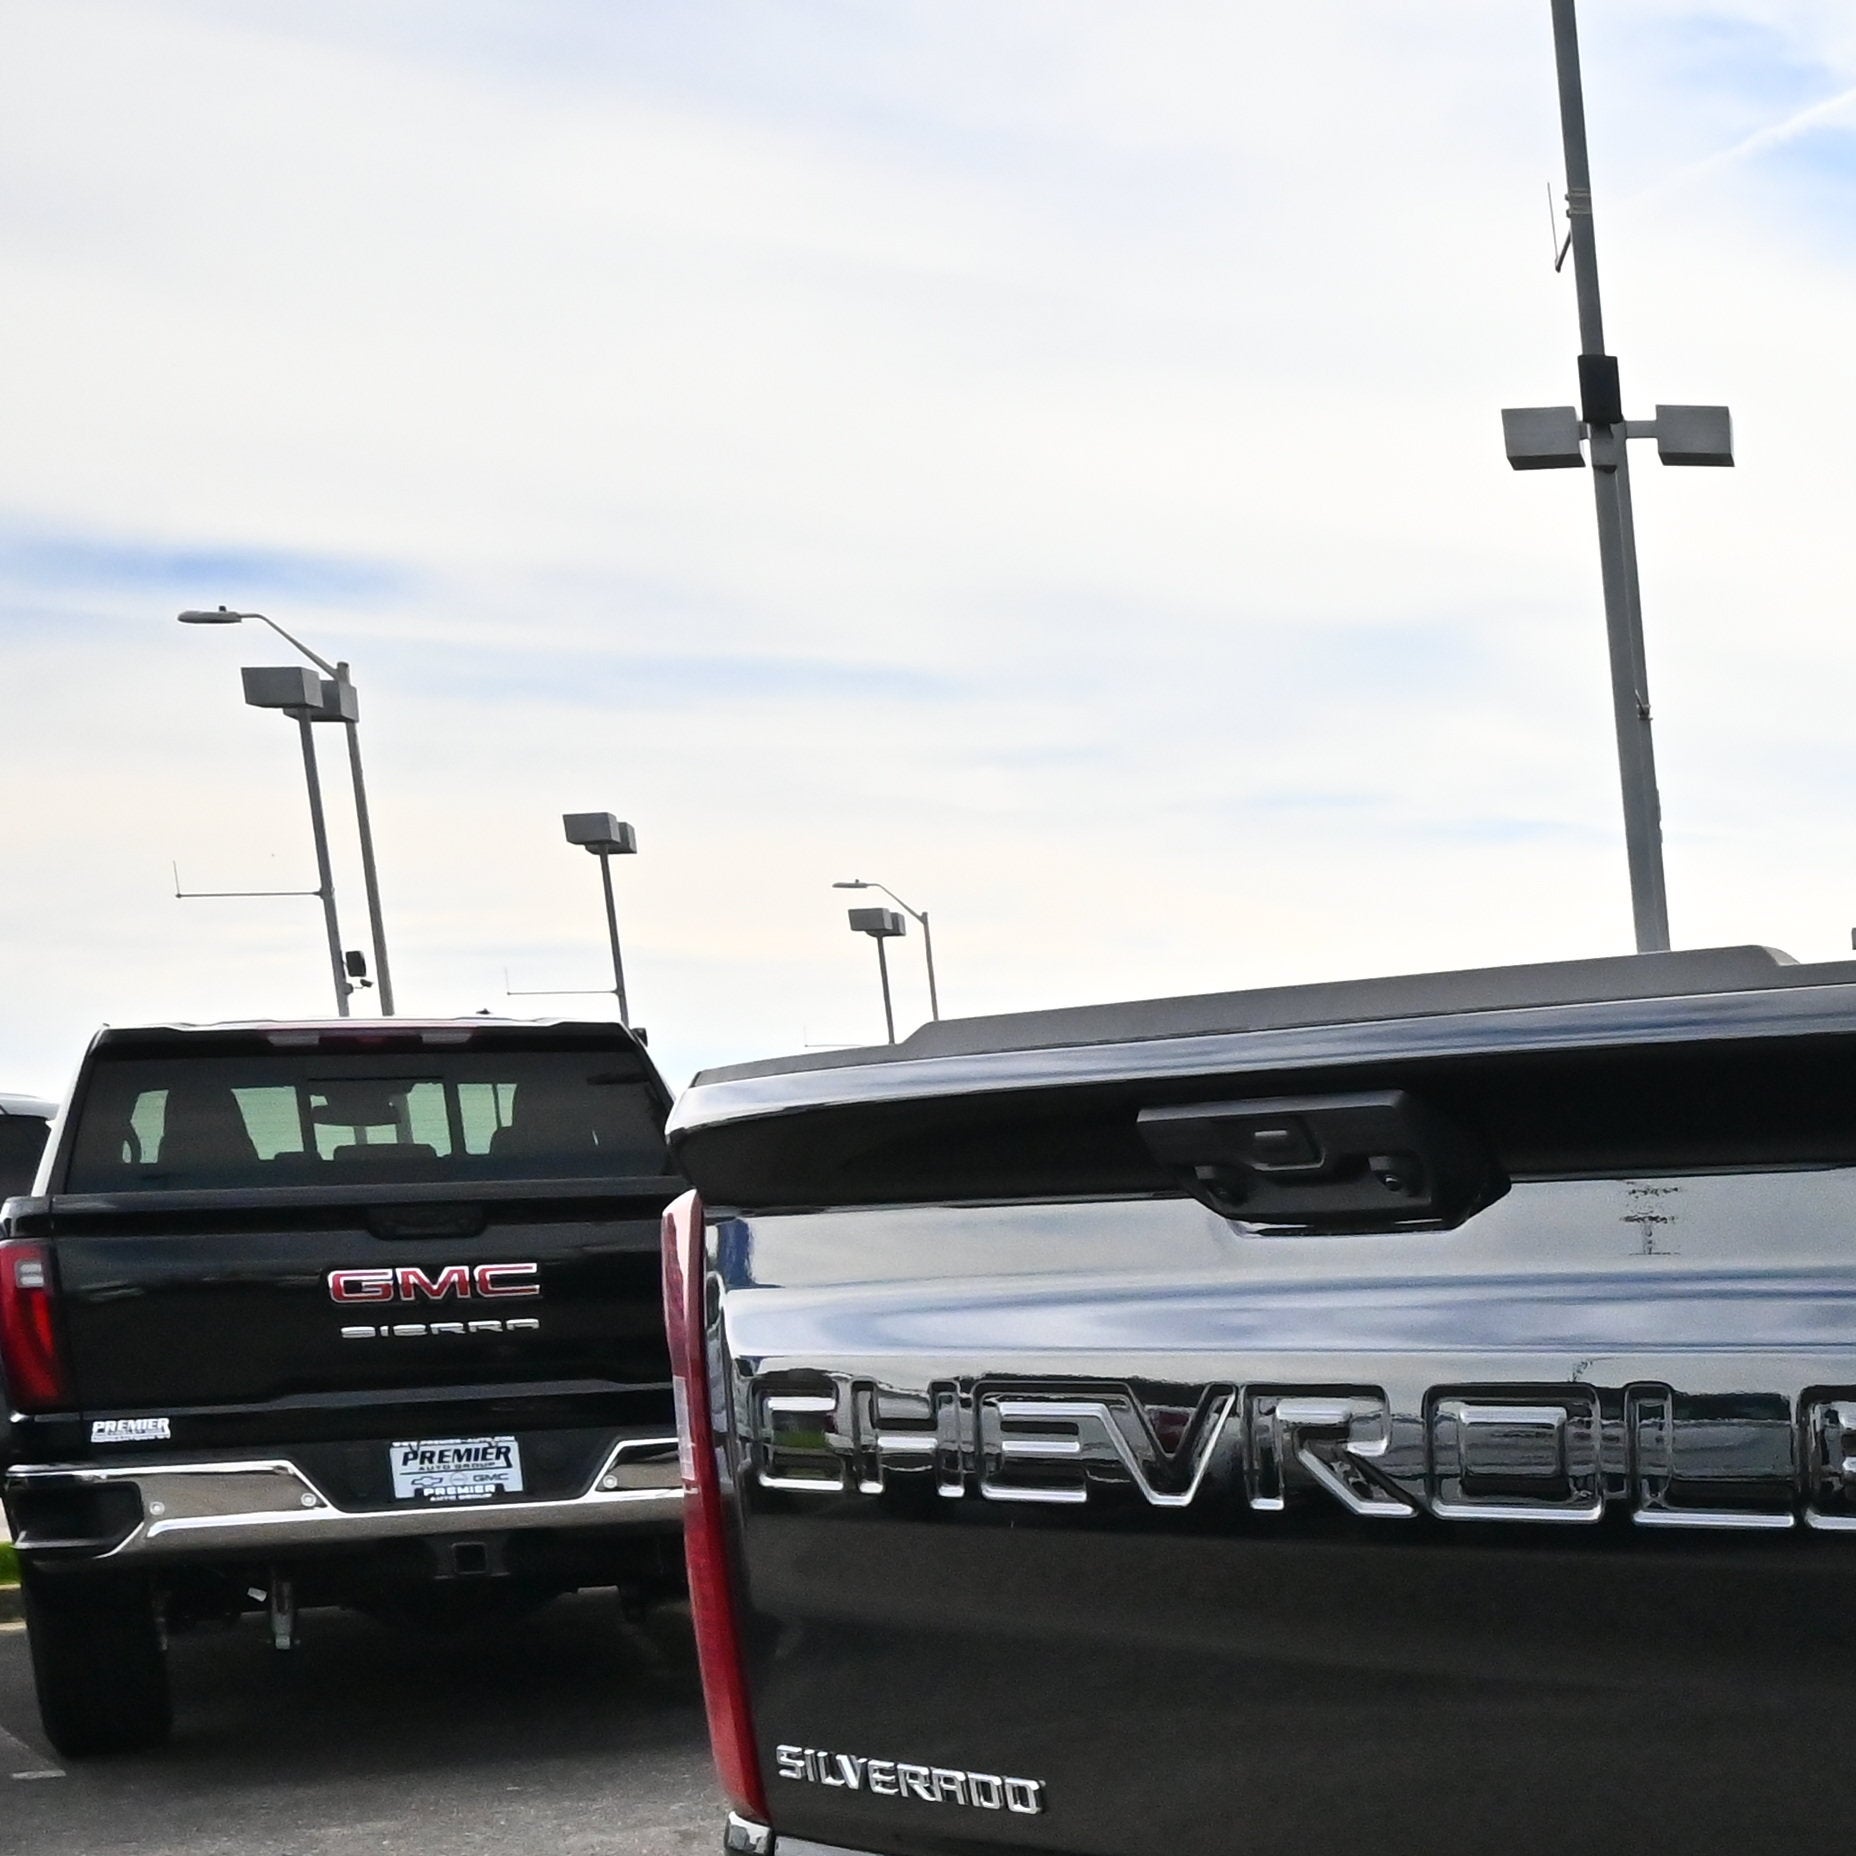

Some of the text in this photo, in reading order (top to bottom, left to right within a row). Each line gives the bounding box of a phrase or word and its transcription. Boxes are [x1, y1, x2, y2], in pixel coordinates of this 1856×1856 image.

[327, 1262, 541, 1304] GMC
[340, 1318, 540, 1339] SIERRA
[92, 1418, 170, 1435] PREMIER
[402, 1446, 513, 1468] PREMIER
[418, 1463, 451, 1471] AUTO
[472, 1472, 510, 1482] GMC
[423, 1484, 496, 1497] PREMIER
[775, 1744, 1046, 1814] SILVERADO
